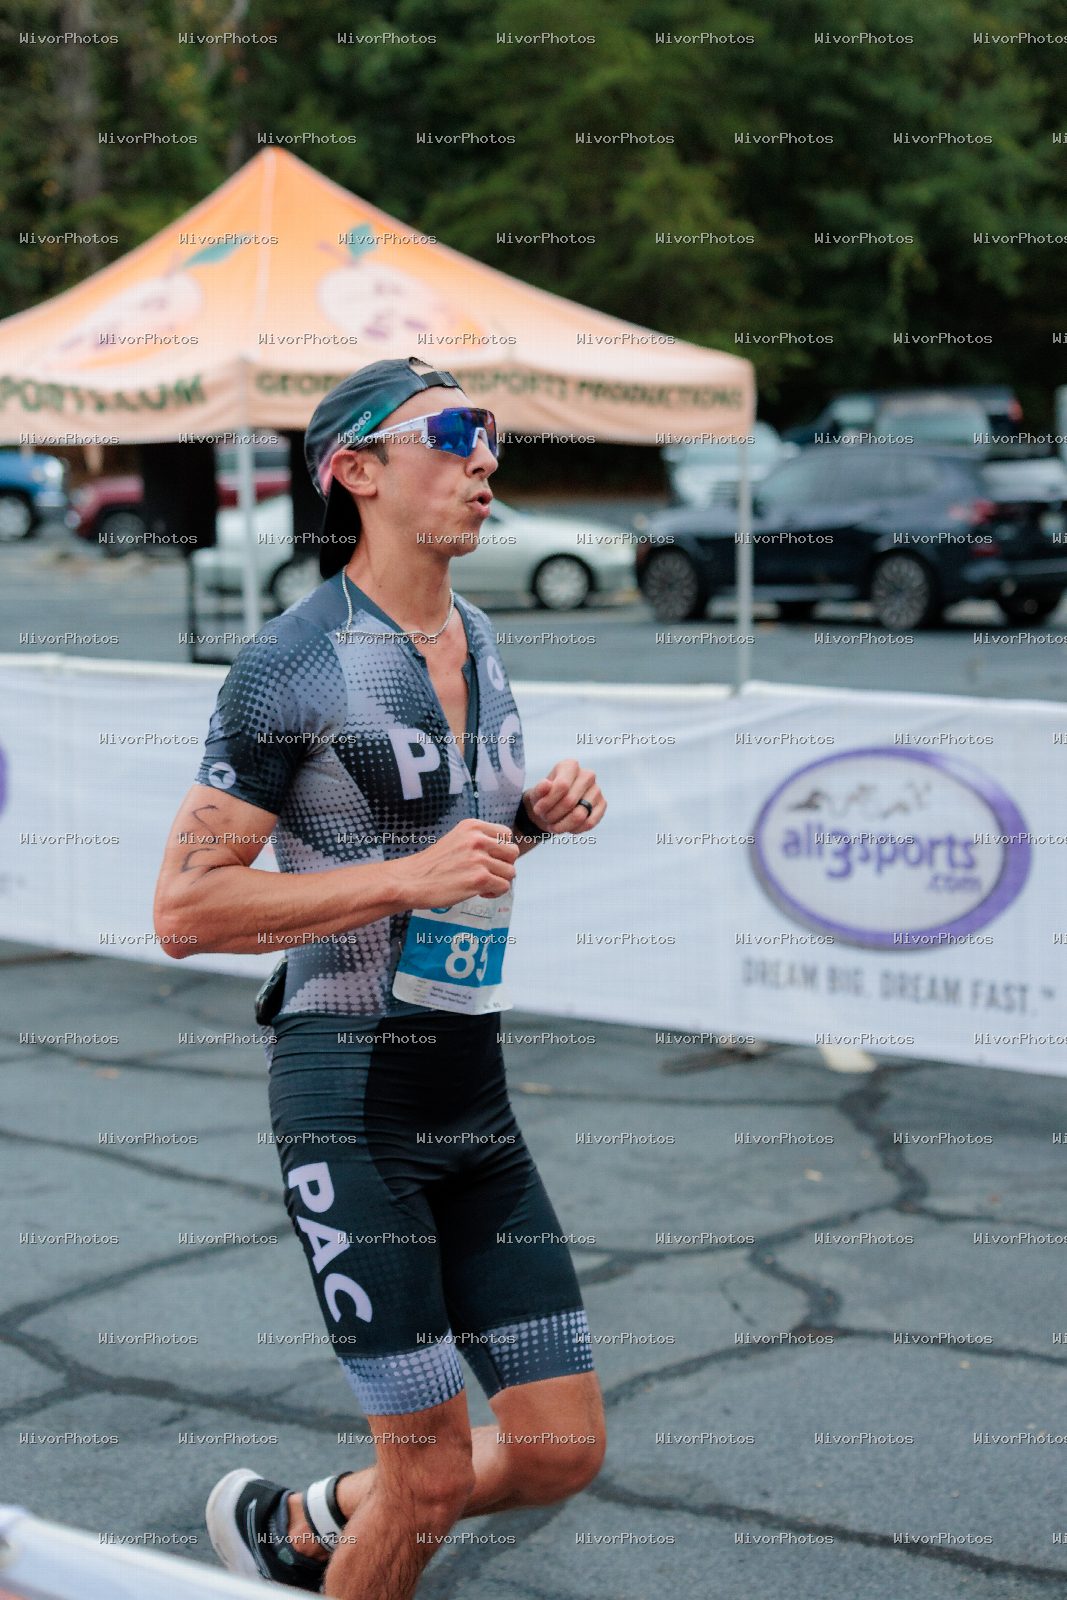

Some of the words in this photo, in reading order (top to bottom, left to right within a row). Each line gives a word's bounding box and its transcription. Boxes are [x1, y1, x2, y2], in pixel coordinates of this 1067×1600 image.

[388, 713, 525, 801] PAC
[780, 822, 976, 879] all3sports
[741, 957, 819, 992] DREAM
[879, 968, 963, 1008] DREAM
[288, 1161, 373, 1323] PAC
